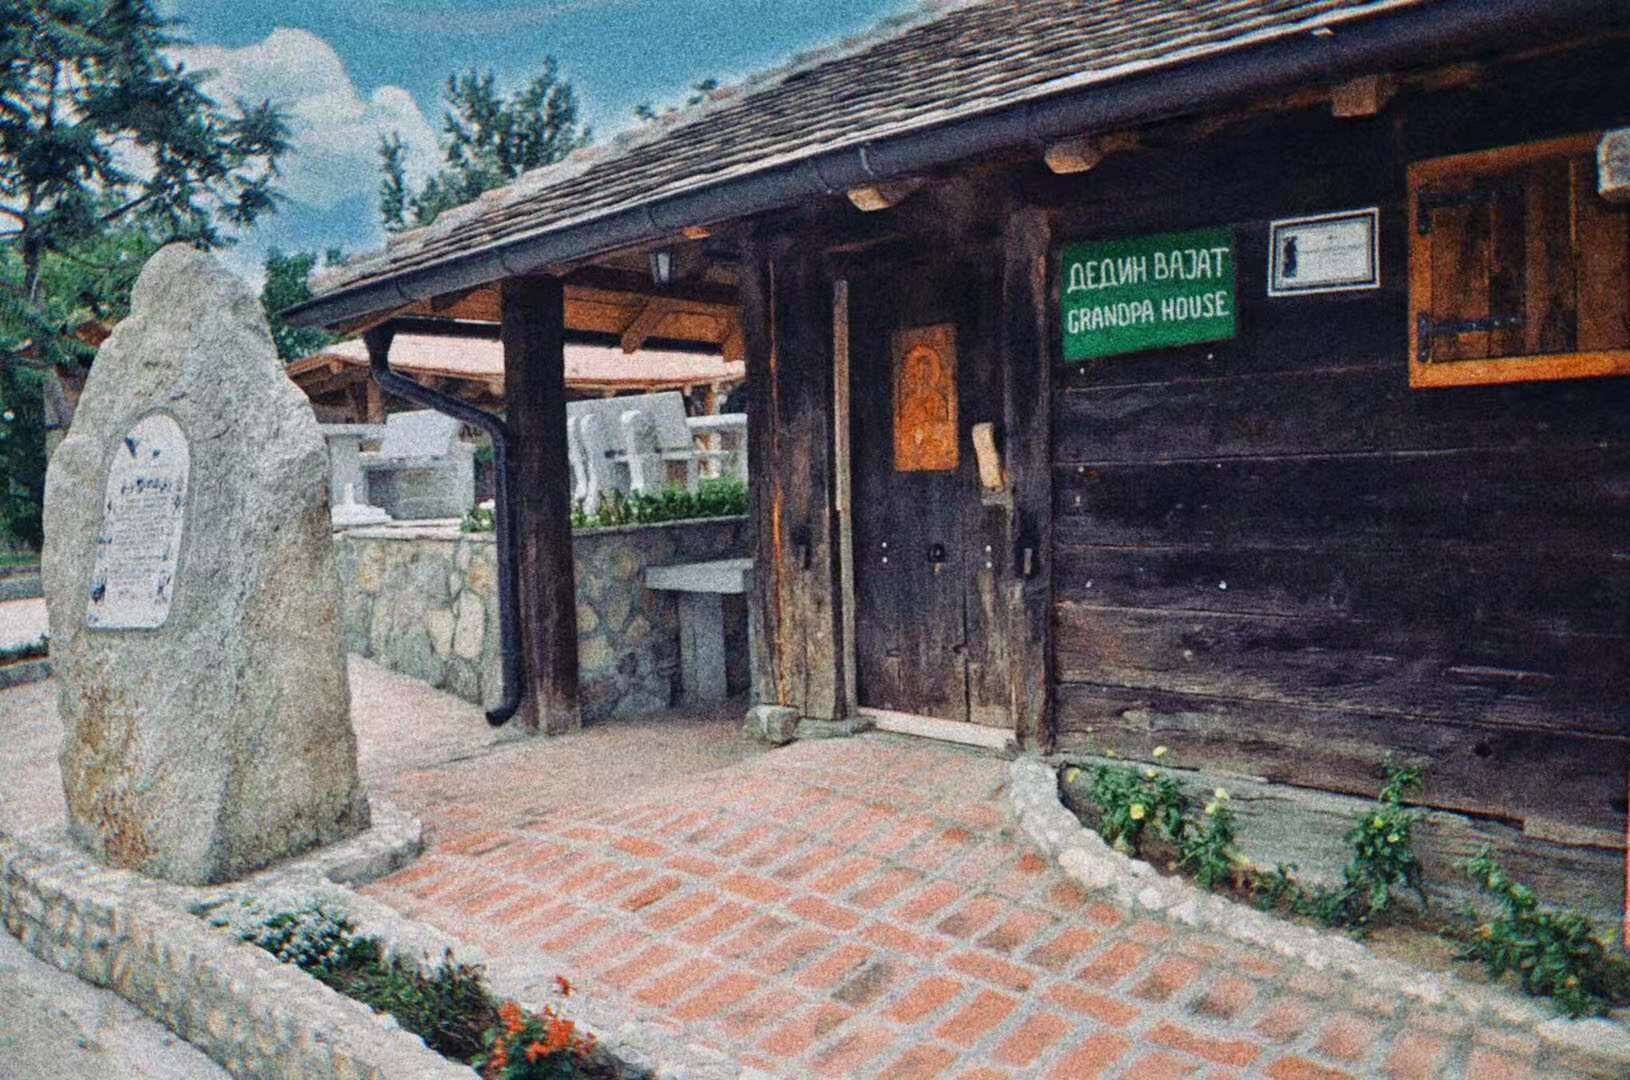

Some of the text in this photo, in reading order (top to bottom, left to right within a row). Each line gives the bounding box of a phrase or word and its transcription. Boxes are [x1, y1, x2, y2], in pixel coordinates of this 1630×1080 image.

[1067, 247, 1230, 293] ДЕДИН ВАЈАТ
[1067, 291, 1231, 334] GRANDPA HOUSE
